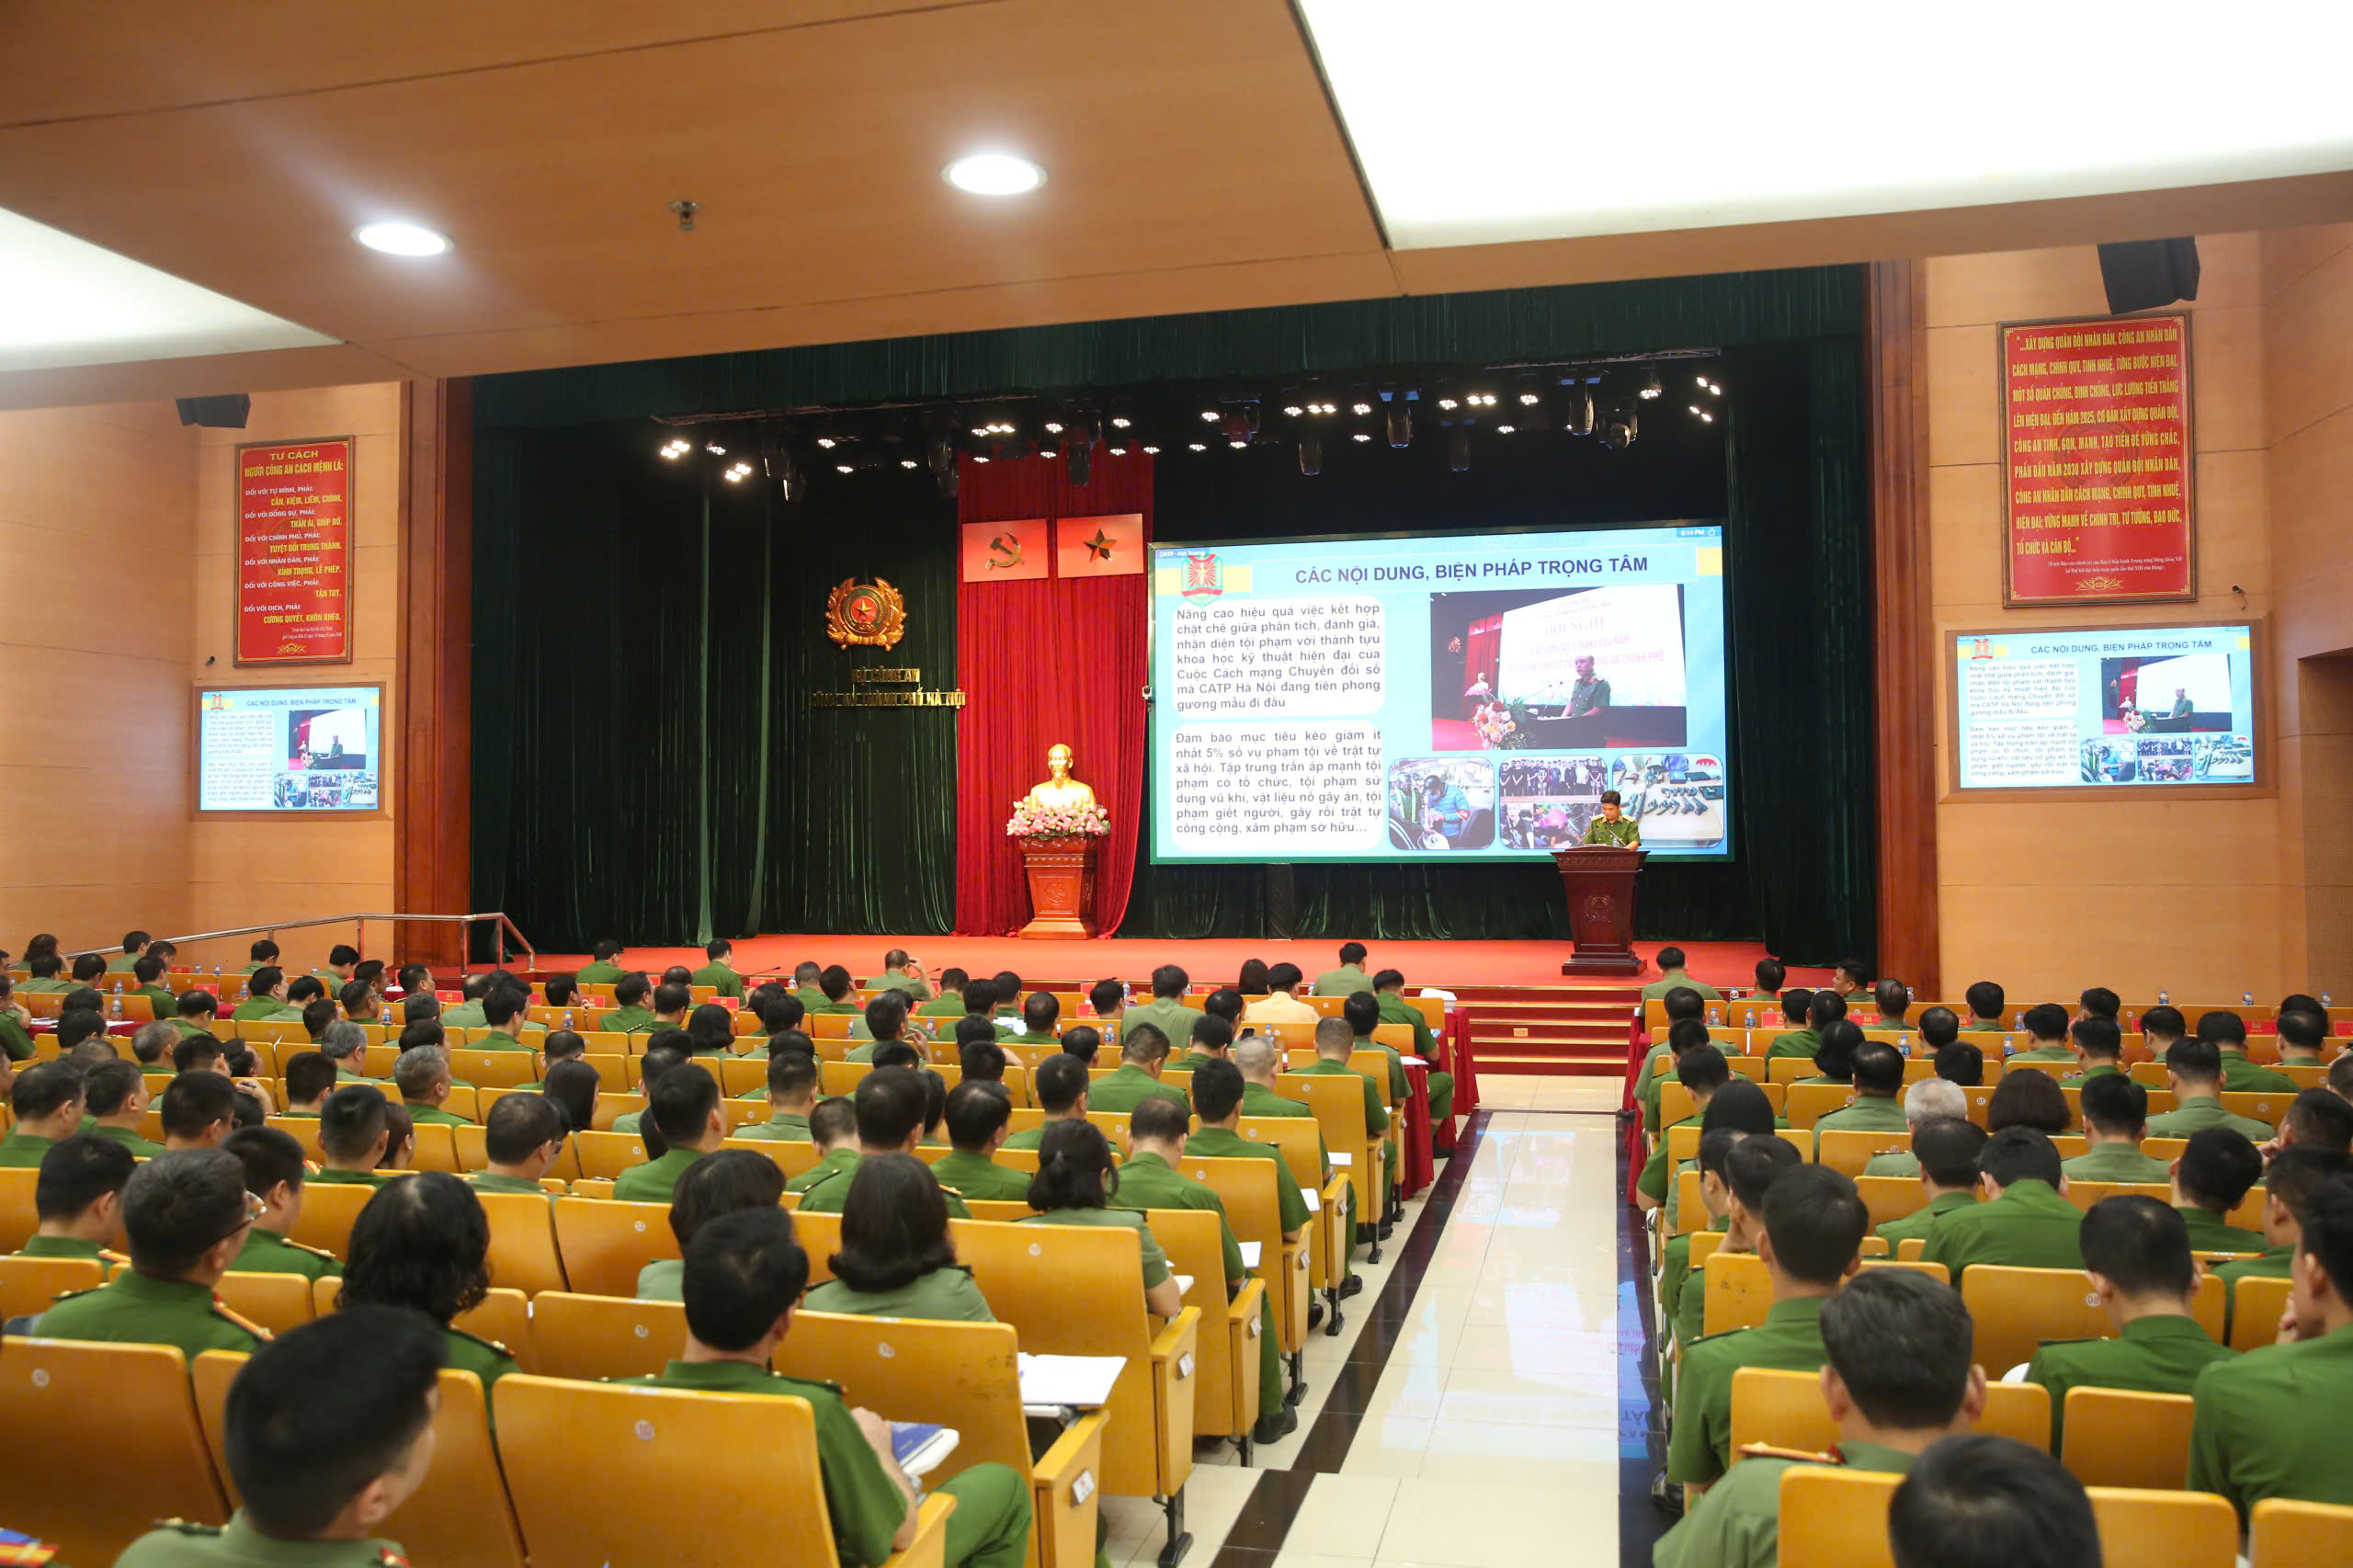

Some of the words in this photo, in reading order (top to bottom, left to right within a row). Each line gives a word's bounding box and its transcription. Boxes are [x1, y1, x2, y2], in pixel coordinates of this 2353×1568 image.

[288, 450, 318, 460] CÁCH
[266, 463, 282, 476] CÔNG
[285, 465, 292, 474] AN
[295, 461, 312, 474] CÁCH
[1296, 564, 1331, 585] CÁC
[1338, 563, 1368, 586] NỘI
[1374, 566, 1429, 584] DUNG,
[1436, 560, 1477, 584] BIỆN
[1483, 558, 1532, 578] PHÁP
[1538, 561, 1602, 580] TRỌNG
[1608, 554, 1647, 574] TÂM
[904, 668, 920, 682] AN
[902, 687, 923, 706] PHỐ
[926, 689, 940, 706] HÀ
[946, 689, 965, 710] NỘI
